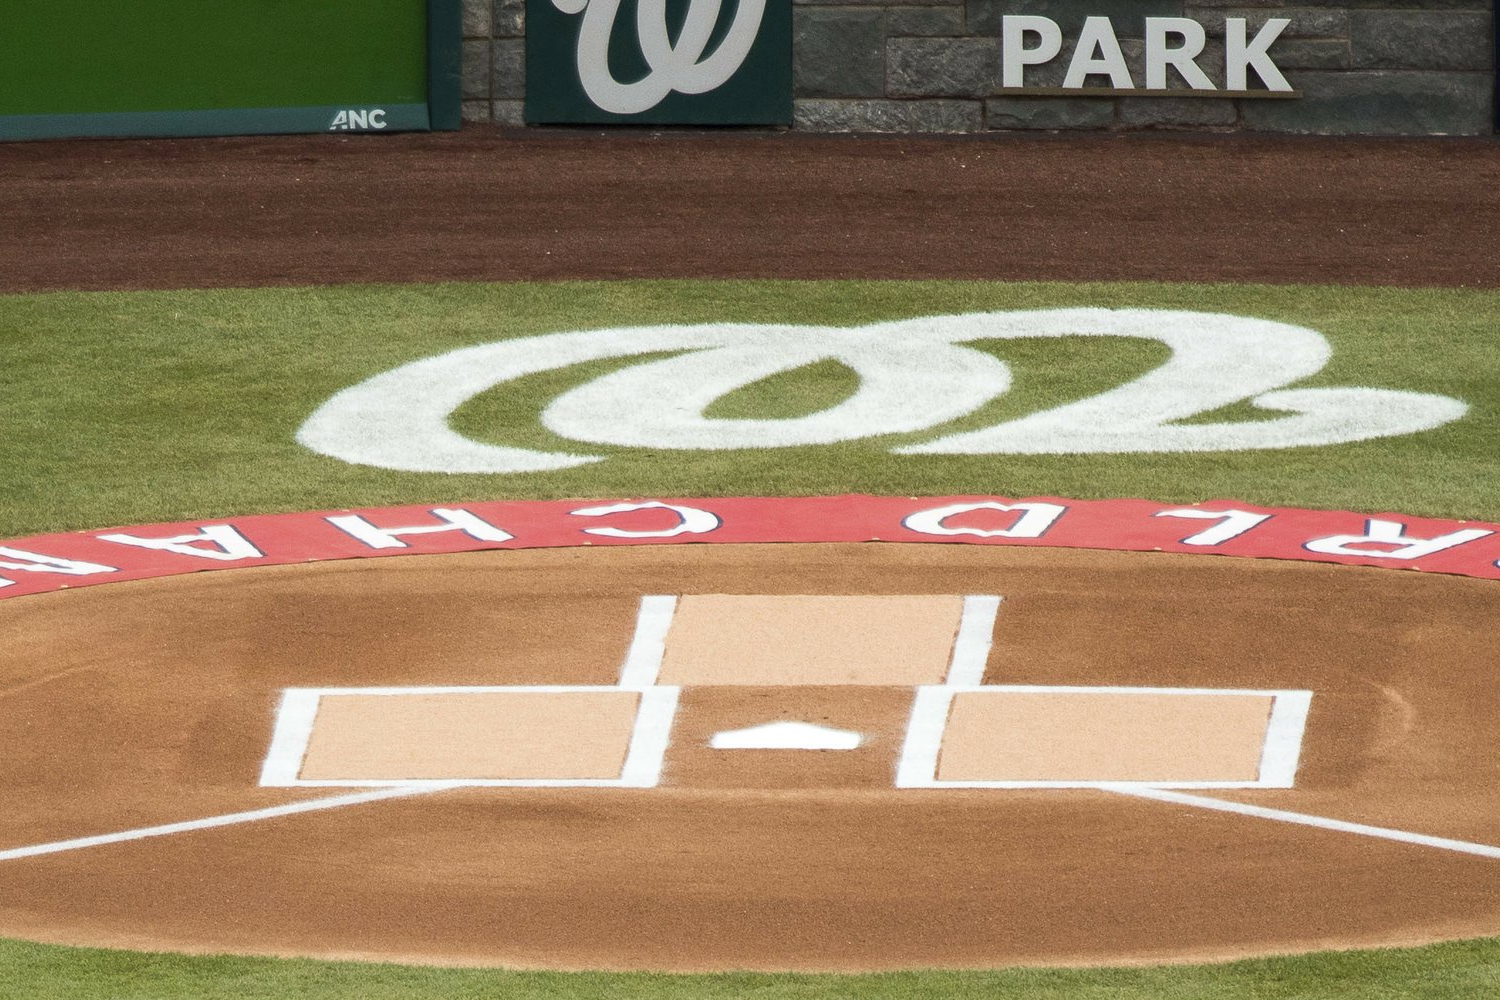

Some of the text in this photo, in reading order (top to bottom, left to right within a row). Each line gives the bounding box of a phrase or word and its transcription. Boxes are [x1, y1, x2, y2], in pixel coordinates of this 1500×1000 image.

[1002, 15, 1295, 92] PARK
[329, 109, 387, 130] ANC
[901, 501, 1500, 571] RLD
